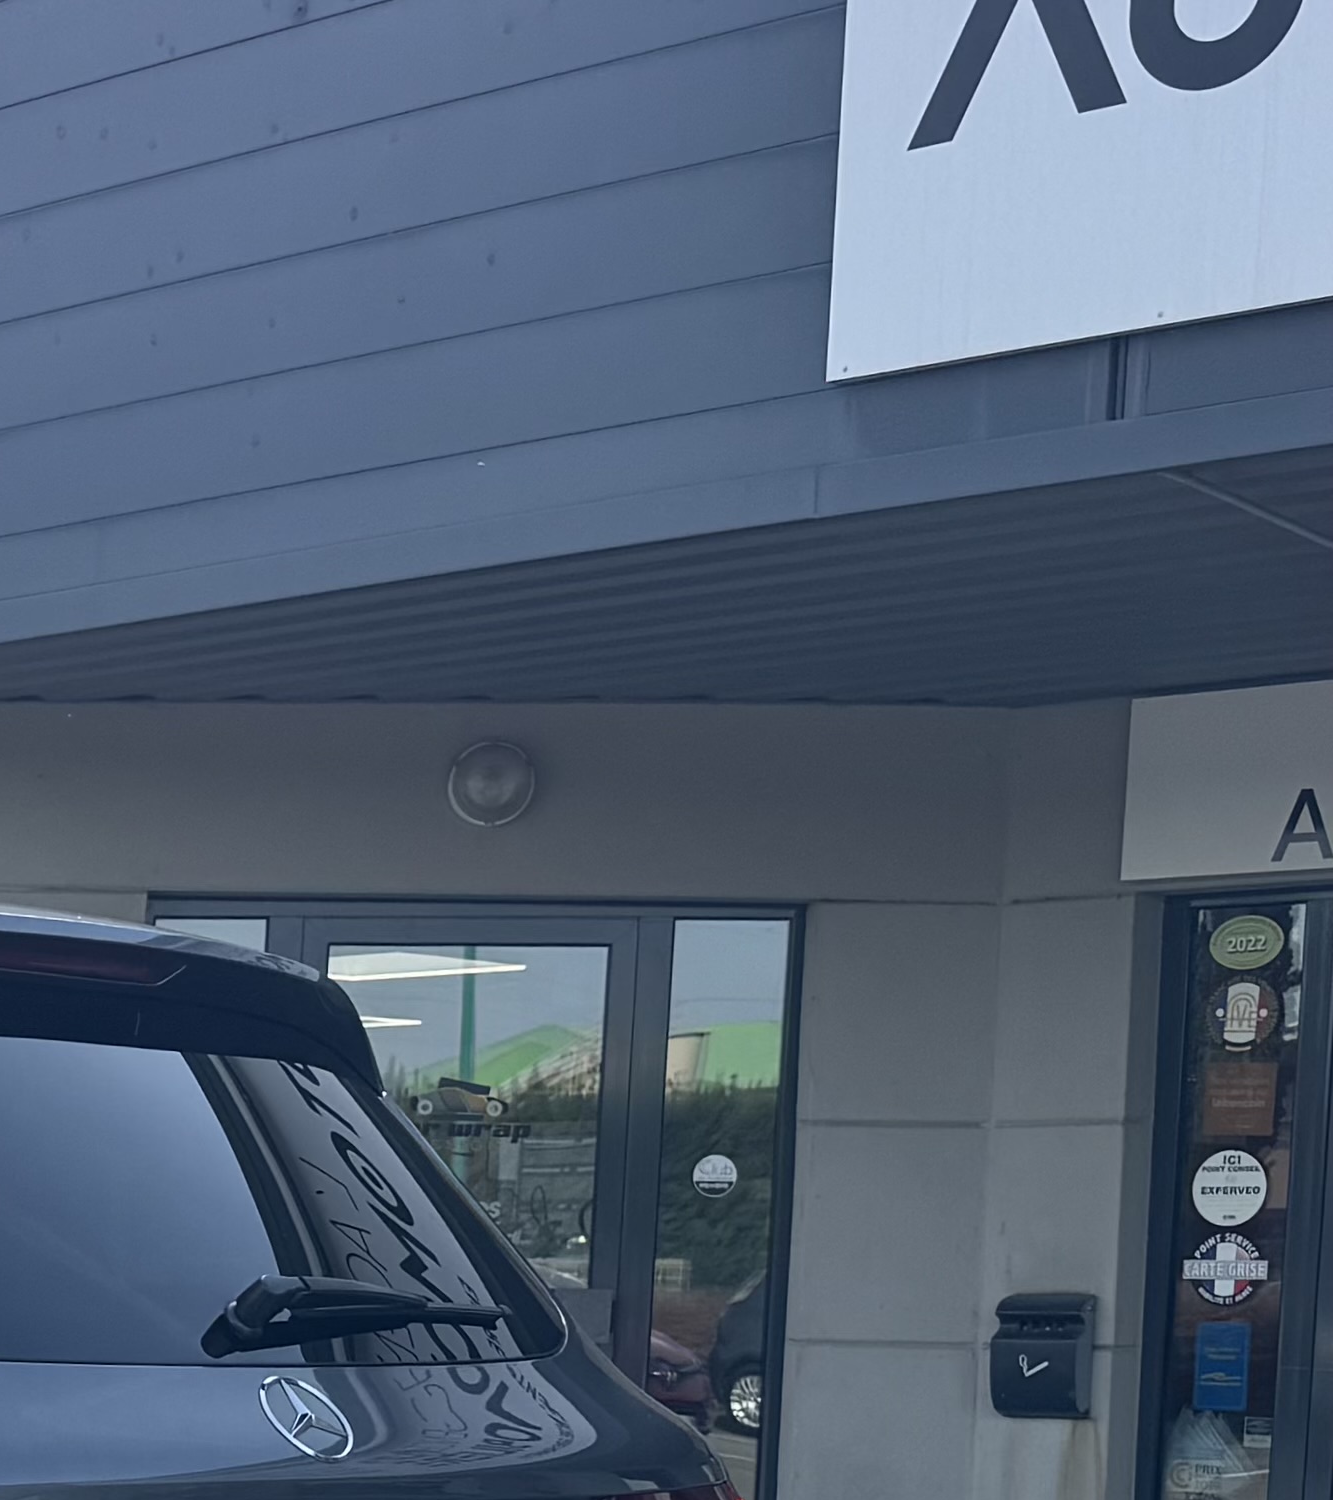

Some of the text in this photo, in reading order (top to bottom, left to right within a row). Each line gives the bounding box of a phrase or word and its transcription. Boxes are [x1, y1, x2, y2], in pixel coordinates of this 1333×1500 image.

[1226, 935, 1267, 953] 2022
[448, 1123, 531, 1144] wrap
[1223, 1155, 1241, 1165] ICI
[1194, 1232, 1260, 1259] POINT SERVICE
[1183, 1262, 1266, 1277] CARTE GRISE
